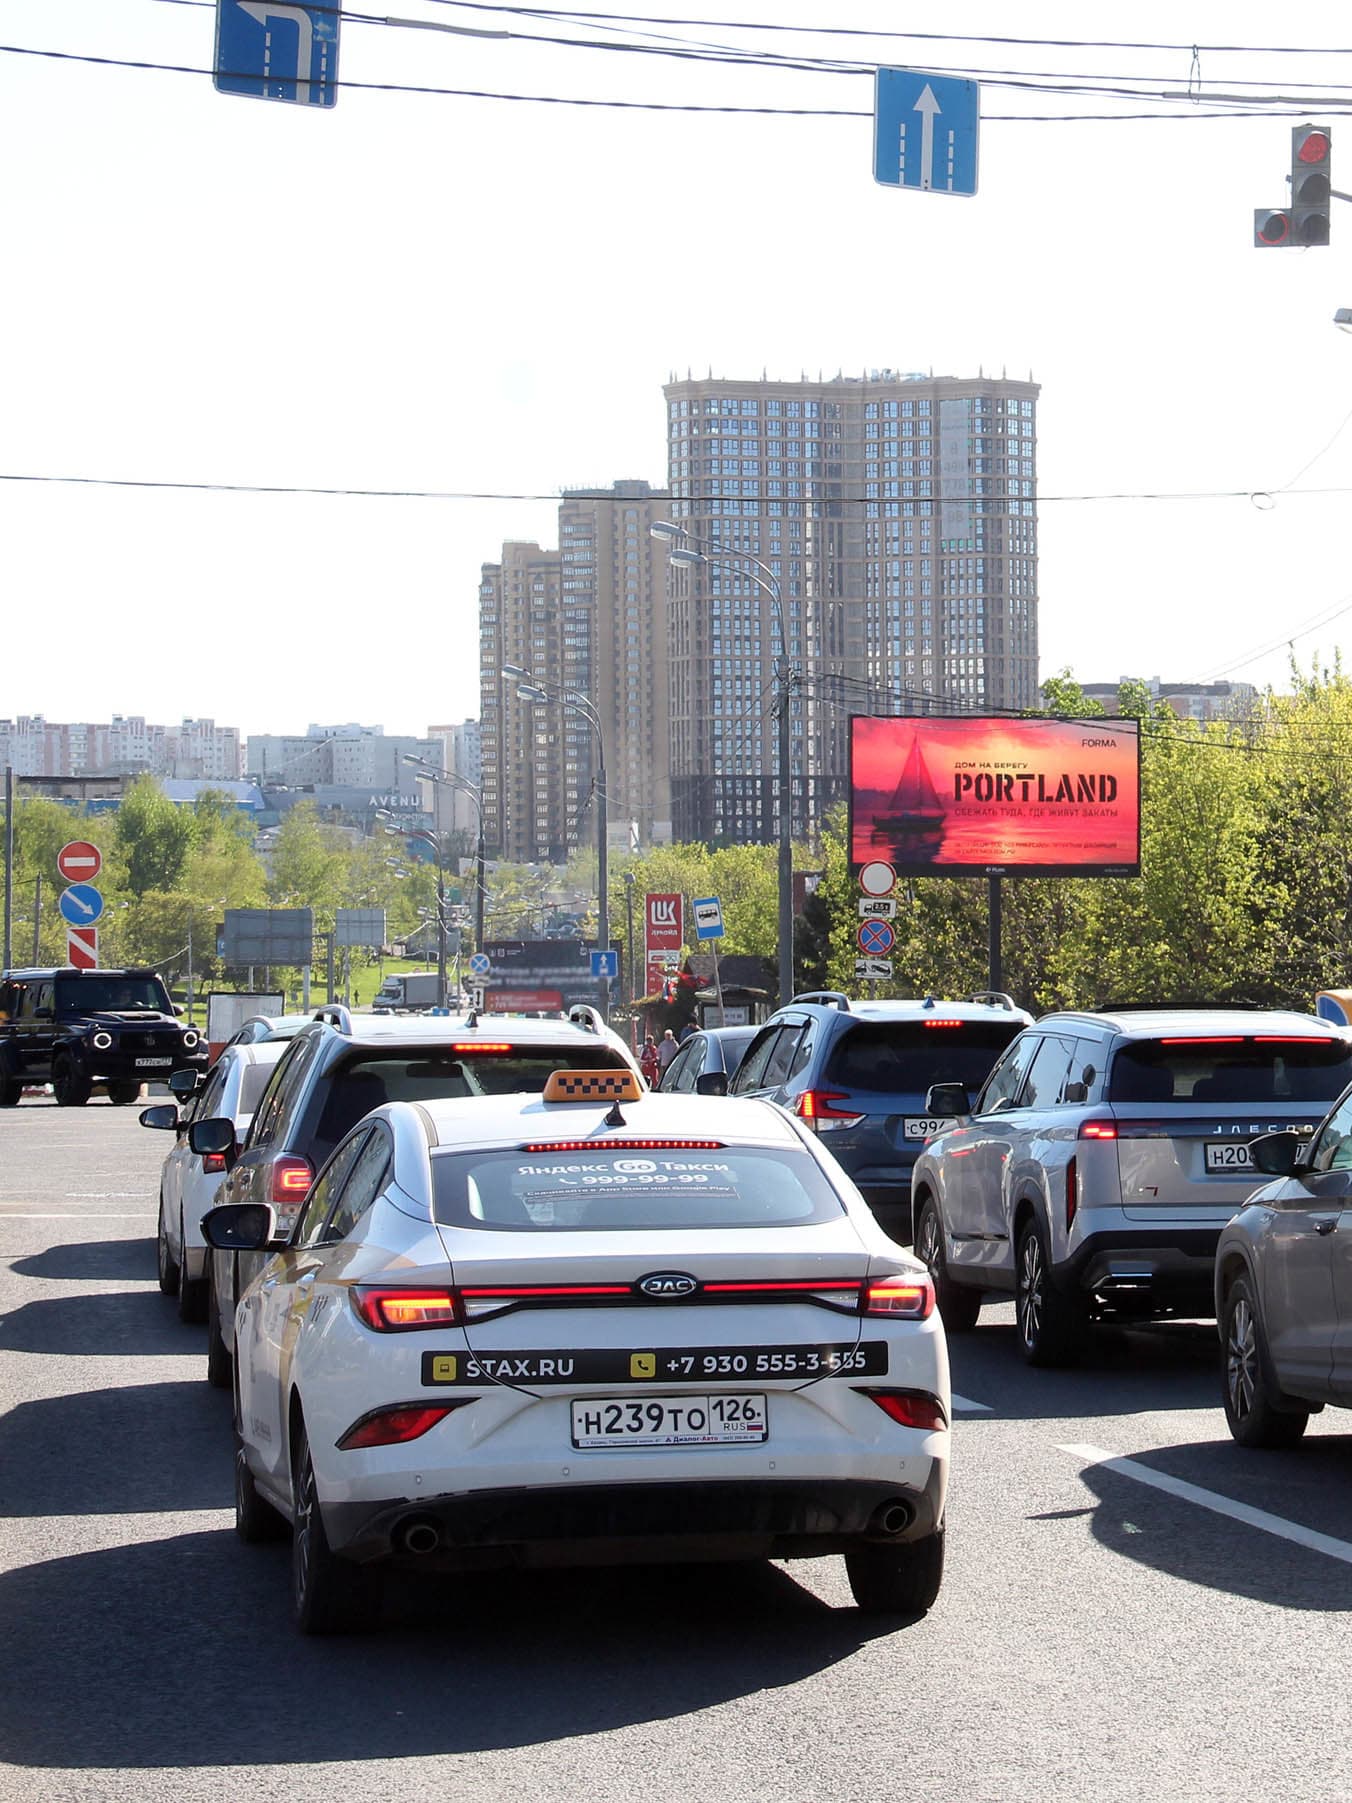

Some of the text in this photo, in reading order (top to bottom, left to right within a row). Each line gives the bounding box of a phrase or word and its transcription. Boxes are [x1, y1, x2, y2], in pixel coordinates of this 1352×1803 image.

[1081, 739, 1117, 747] FORMA
[954, 773, 1118, 803] PORTLAND
[518, 1161, 729, 1175] Яндекс Go Такси
[582, 1174, 709, 1185] 999-99-99
[650, 1280, 688, 1291] JAC
[466, 1357, 575, 1379] STAX.RU
[667, 1351, 867, 1375] +7 930 555-3-555
[585, 1399, 755, 1434] Н239ТО 126
[723, 1422, 746, 1431] RUS
